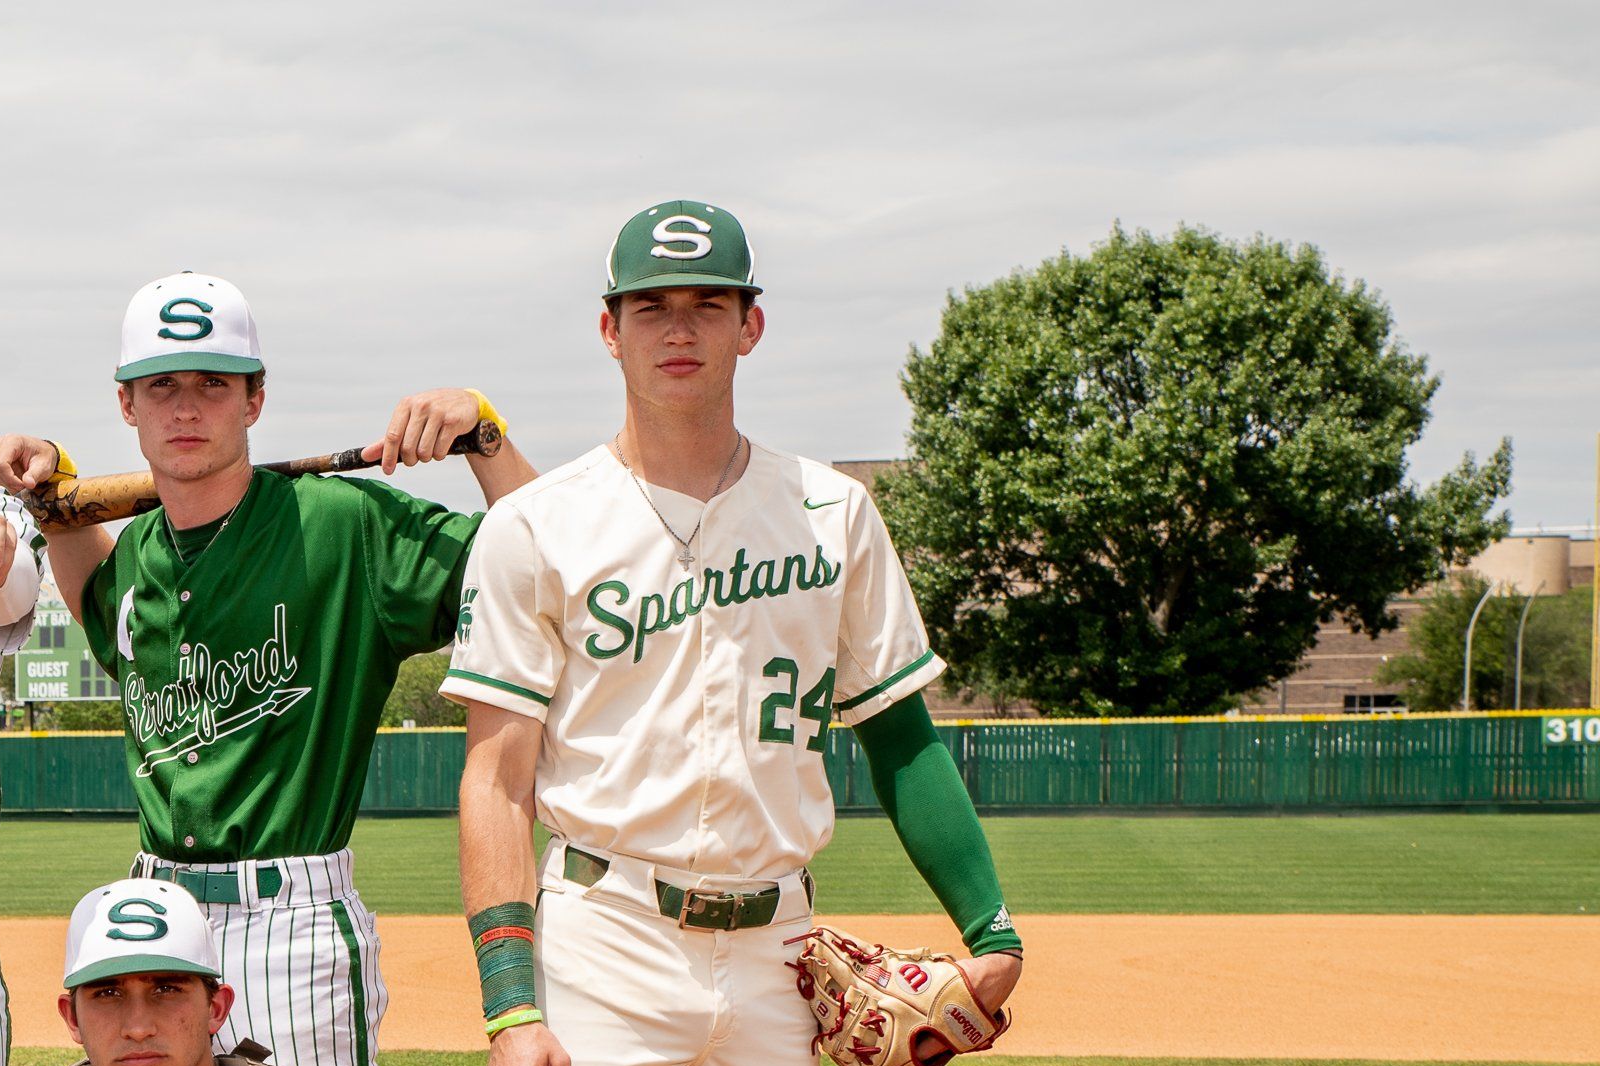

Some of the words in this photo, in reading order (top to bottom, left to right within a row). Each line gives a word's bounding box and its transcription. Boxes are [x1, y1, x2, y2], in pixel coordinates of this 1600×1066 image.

[650, 214, 714, 260] S
[157, 298, 214, 341] S
[585, 544, 842, 664] Spartans
[27, 661, 70, 678] GUEST
[28, 682, 69, 698] HOME
[125, 603, 298, 747] Stratford
[758, 656, 836, 753] 24
[1546, 717, 1600, 743] 310
[105, 898, 169, 942] S
[950, 1007, 984, 1045] Wilson
